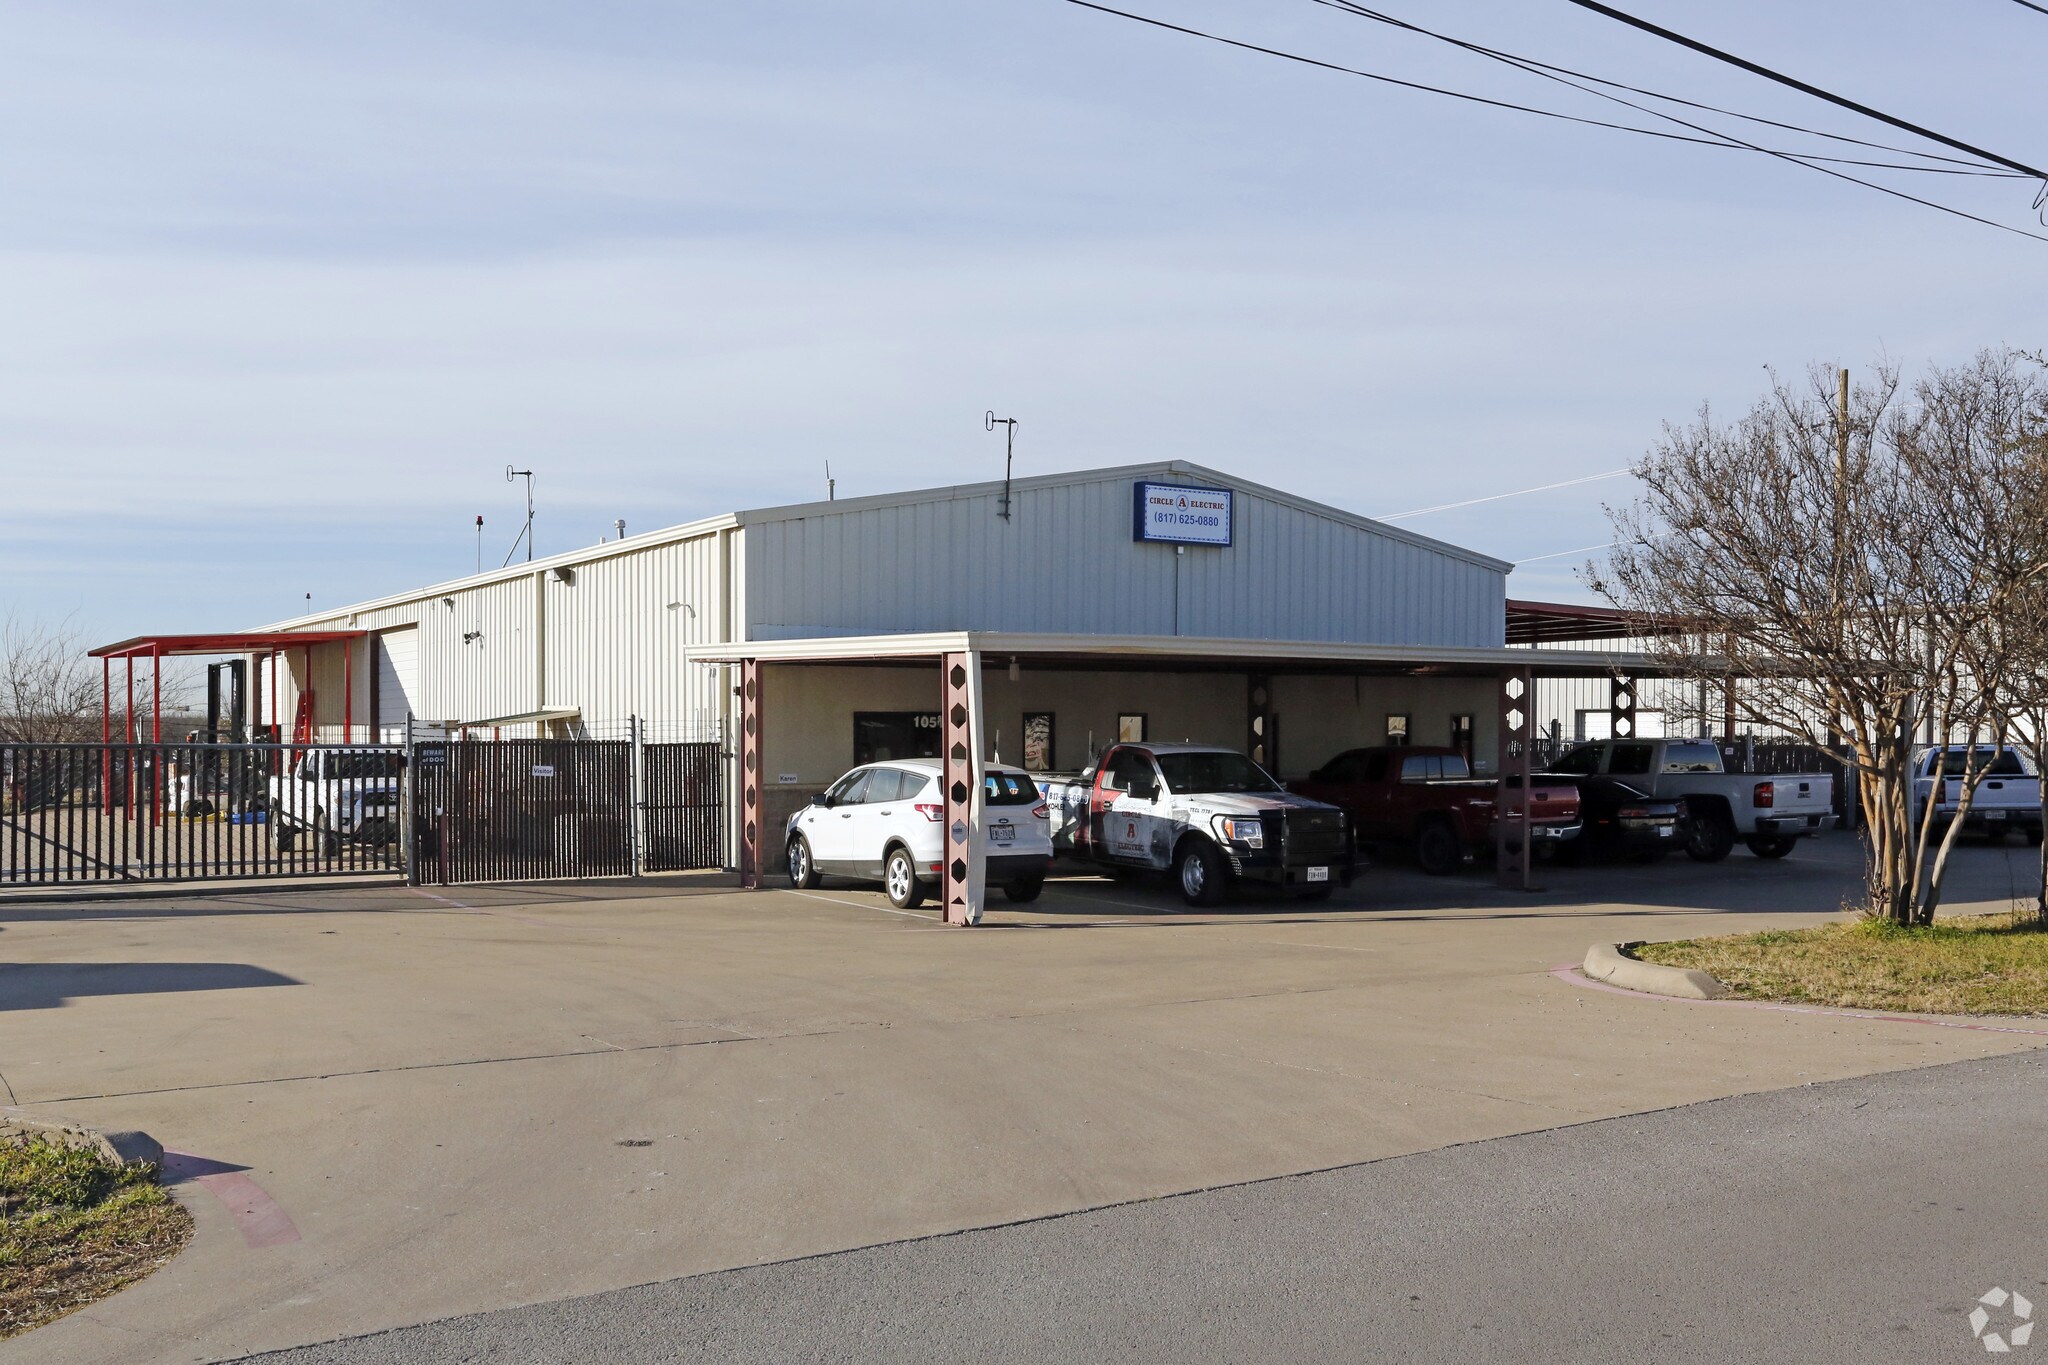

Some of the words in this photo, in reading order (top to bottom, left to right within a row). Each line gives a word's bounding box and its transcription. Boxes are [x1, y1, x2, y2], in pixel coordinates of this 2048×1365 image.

[1149, 497, 1174, 506] CIRCLE
[1178, 497, 1186, 507] A
[1190, 501, 1225, 510] ELECTRIC
[1154, 511, 1177, 524] (817)
[1179, 514, 1219, 527] 625-0880
